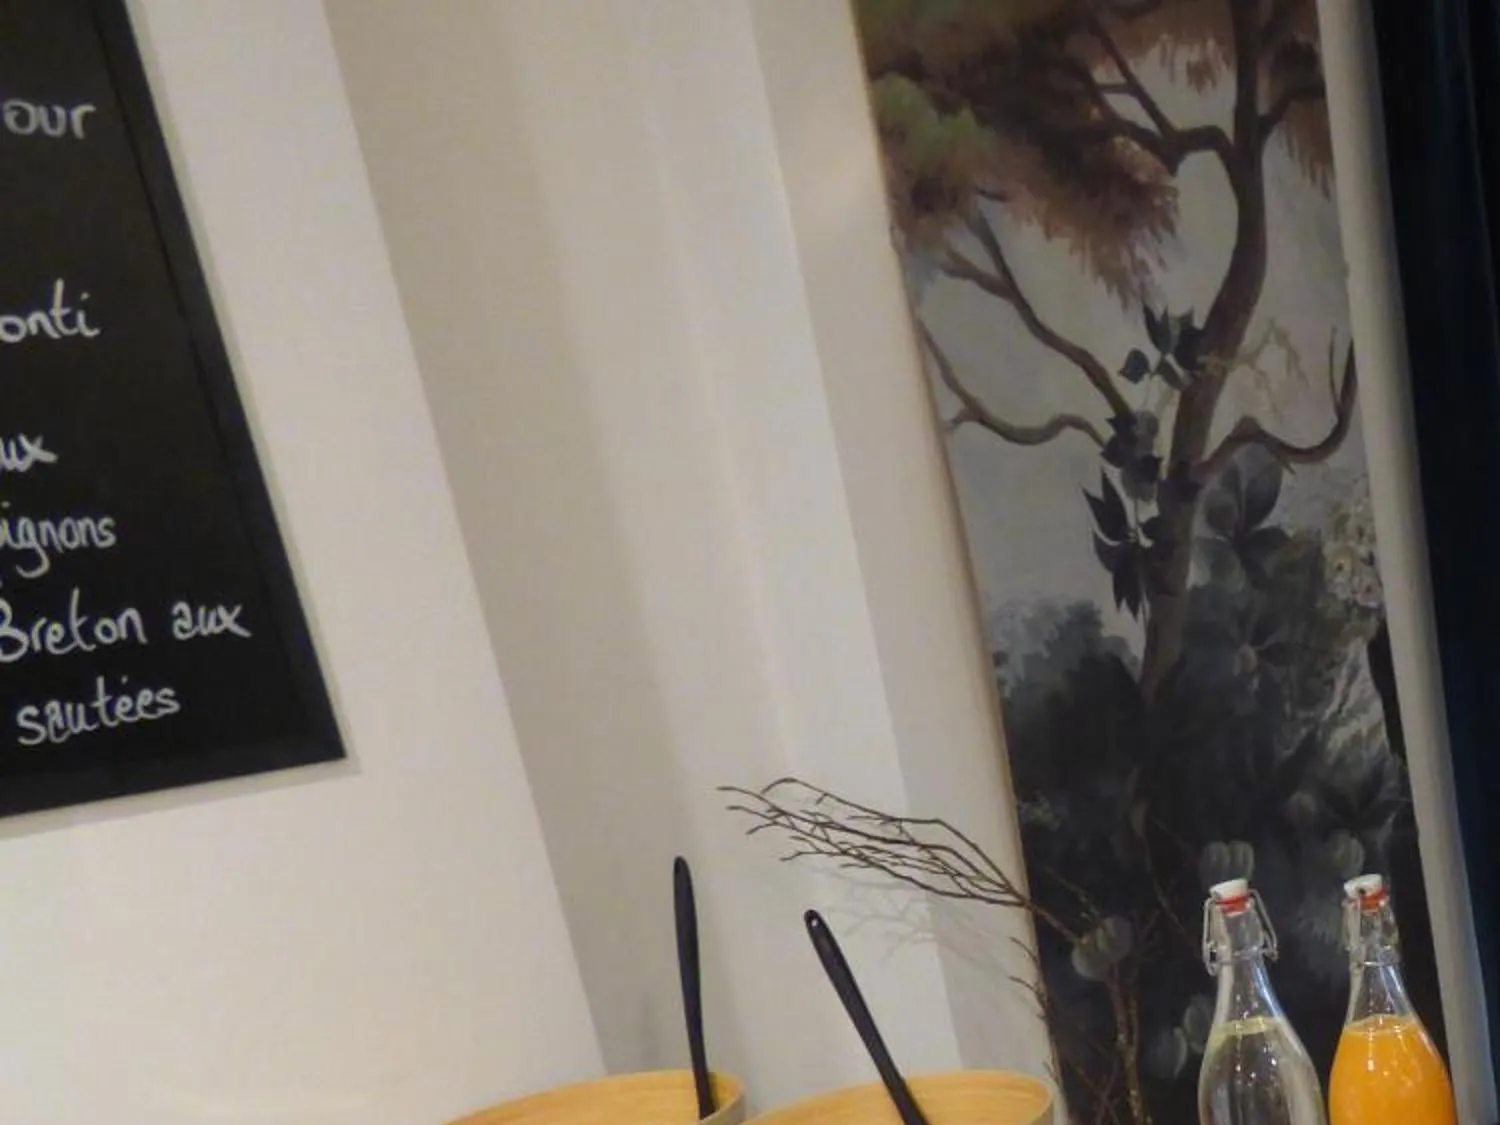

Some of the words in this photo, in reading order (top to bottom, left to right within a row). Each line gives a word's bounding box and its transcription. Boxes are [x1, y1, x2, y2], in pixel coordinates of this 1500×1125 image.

[0, 501, 118, 579] ignons
[0, 586, 148, 663] Breton
[171, 601, 252, 641] aux
